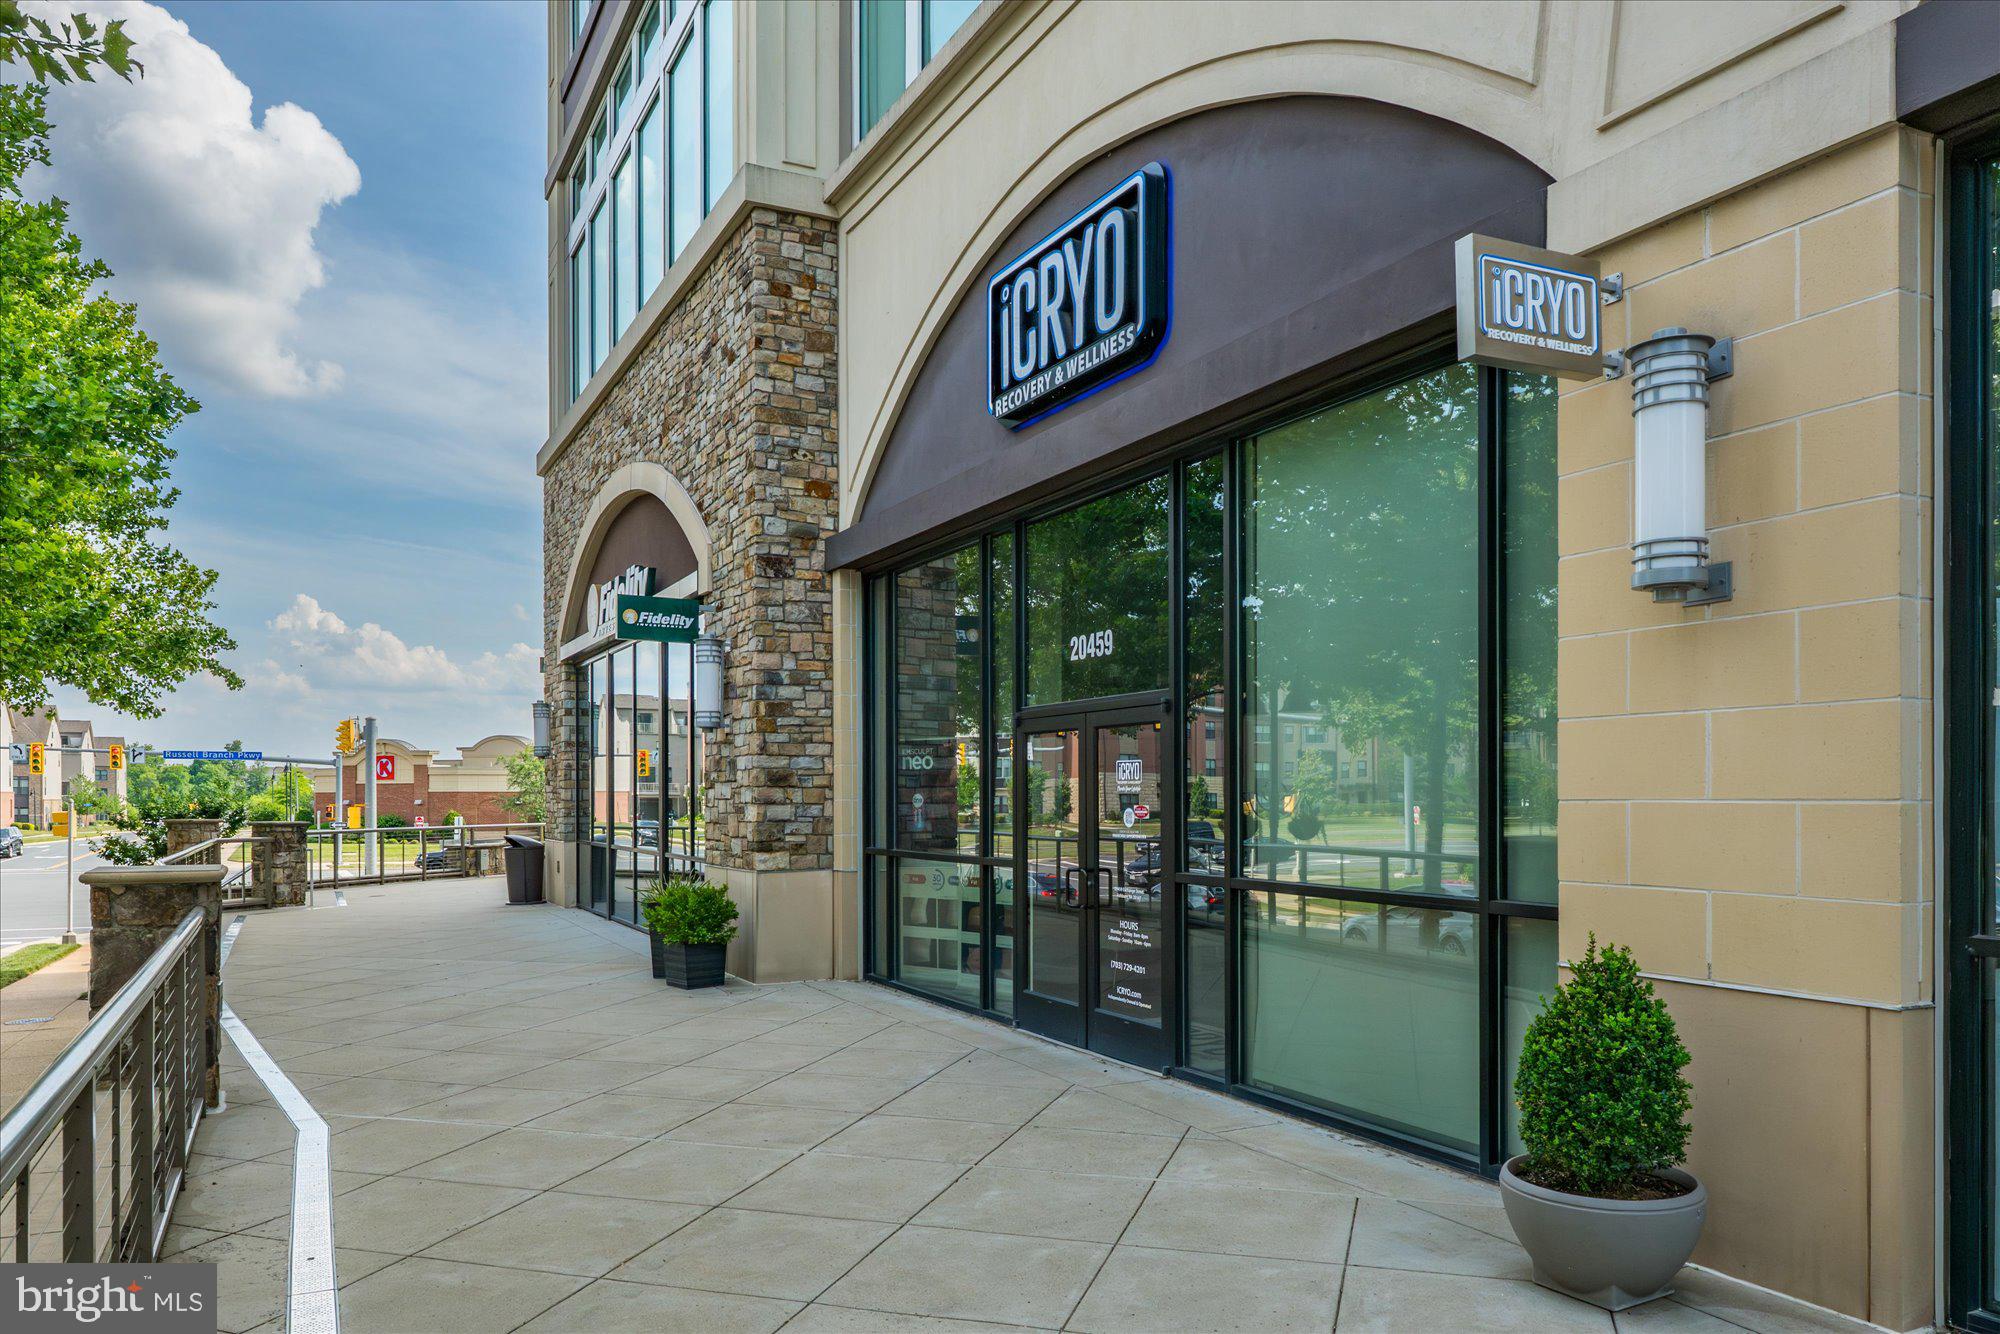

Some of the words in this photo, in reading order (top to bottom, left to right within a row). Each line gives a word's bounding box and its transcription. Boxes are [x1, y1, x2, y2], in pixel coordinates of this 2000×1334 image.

[1001, 206, 1125, 390] iCRYO
[1493, 267, 1586, 339] iCRYO
[1487, 328, 1537, 346] RECOVERY
[1537, 337, 1546, 348] &
[1546, 338, 1594, 357] WELLNESS
[994, 371, 1052, 418] RECOVERY
[1054, 366, 1065, 386] &
[1066, 325, 1136, 379] WELLNESS
[638, 611, 695, 629] Fidelity
[1070, 629, 1113, 661] 20459
[165, 751, 199, 759] Russell
[202, 751, 234, 759] Branch
[237, 752, 261, 760] Pkwy
[902, 755, 934, 770] neo
[379, 760, 392, 775] K
[1118, 762, 1140, 781] iCRYO
[1119, 920, 1139, 931] HOURS
